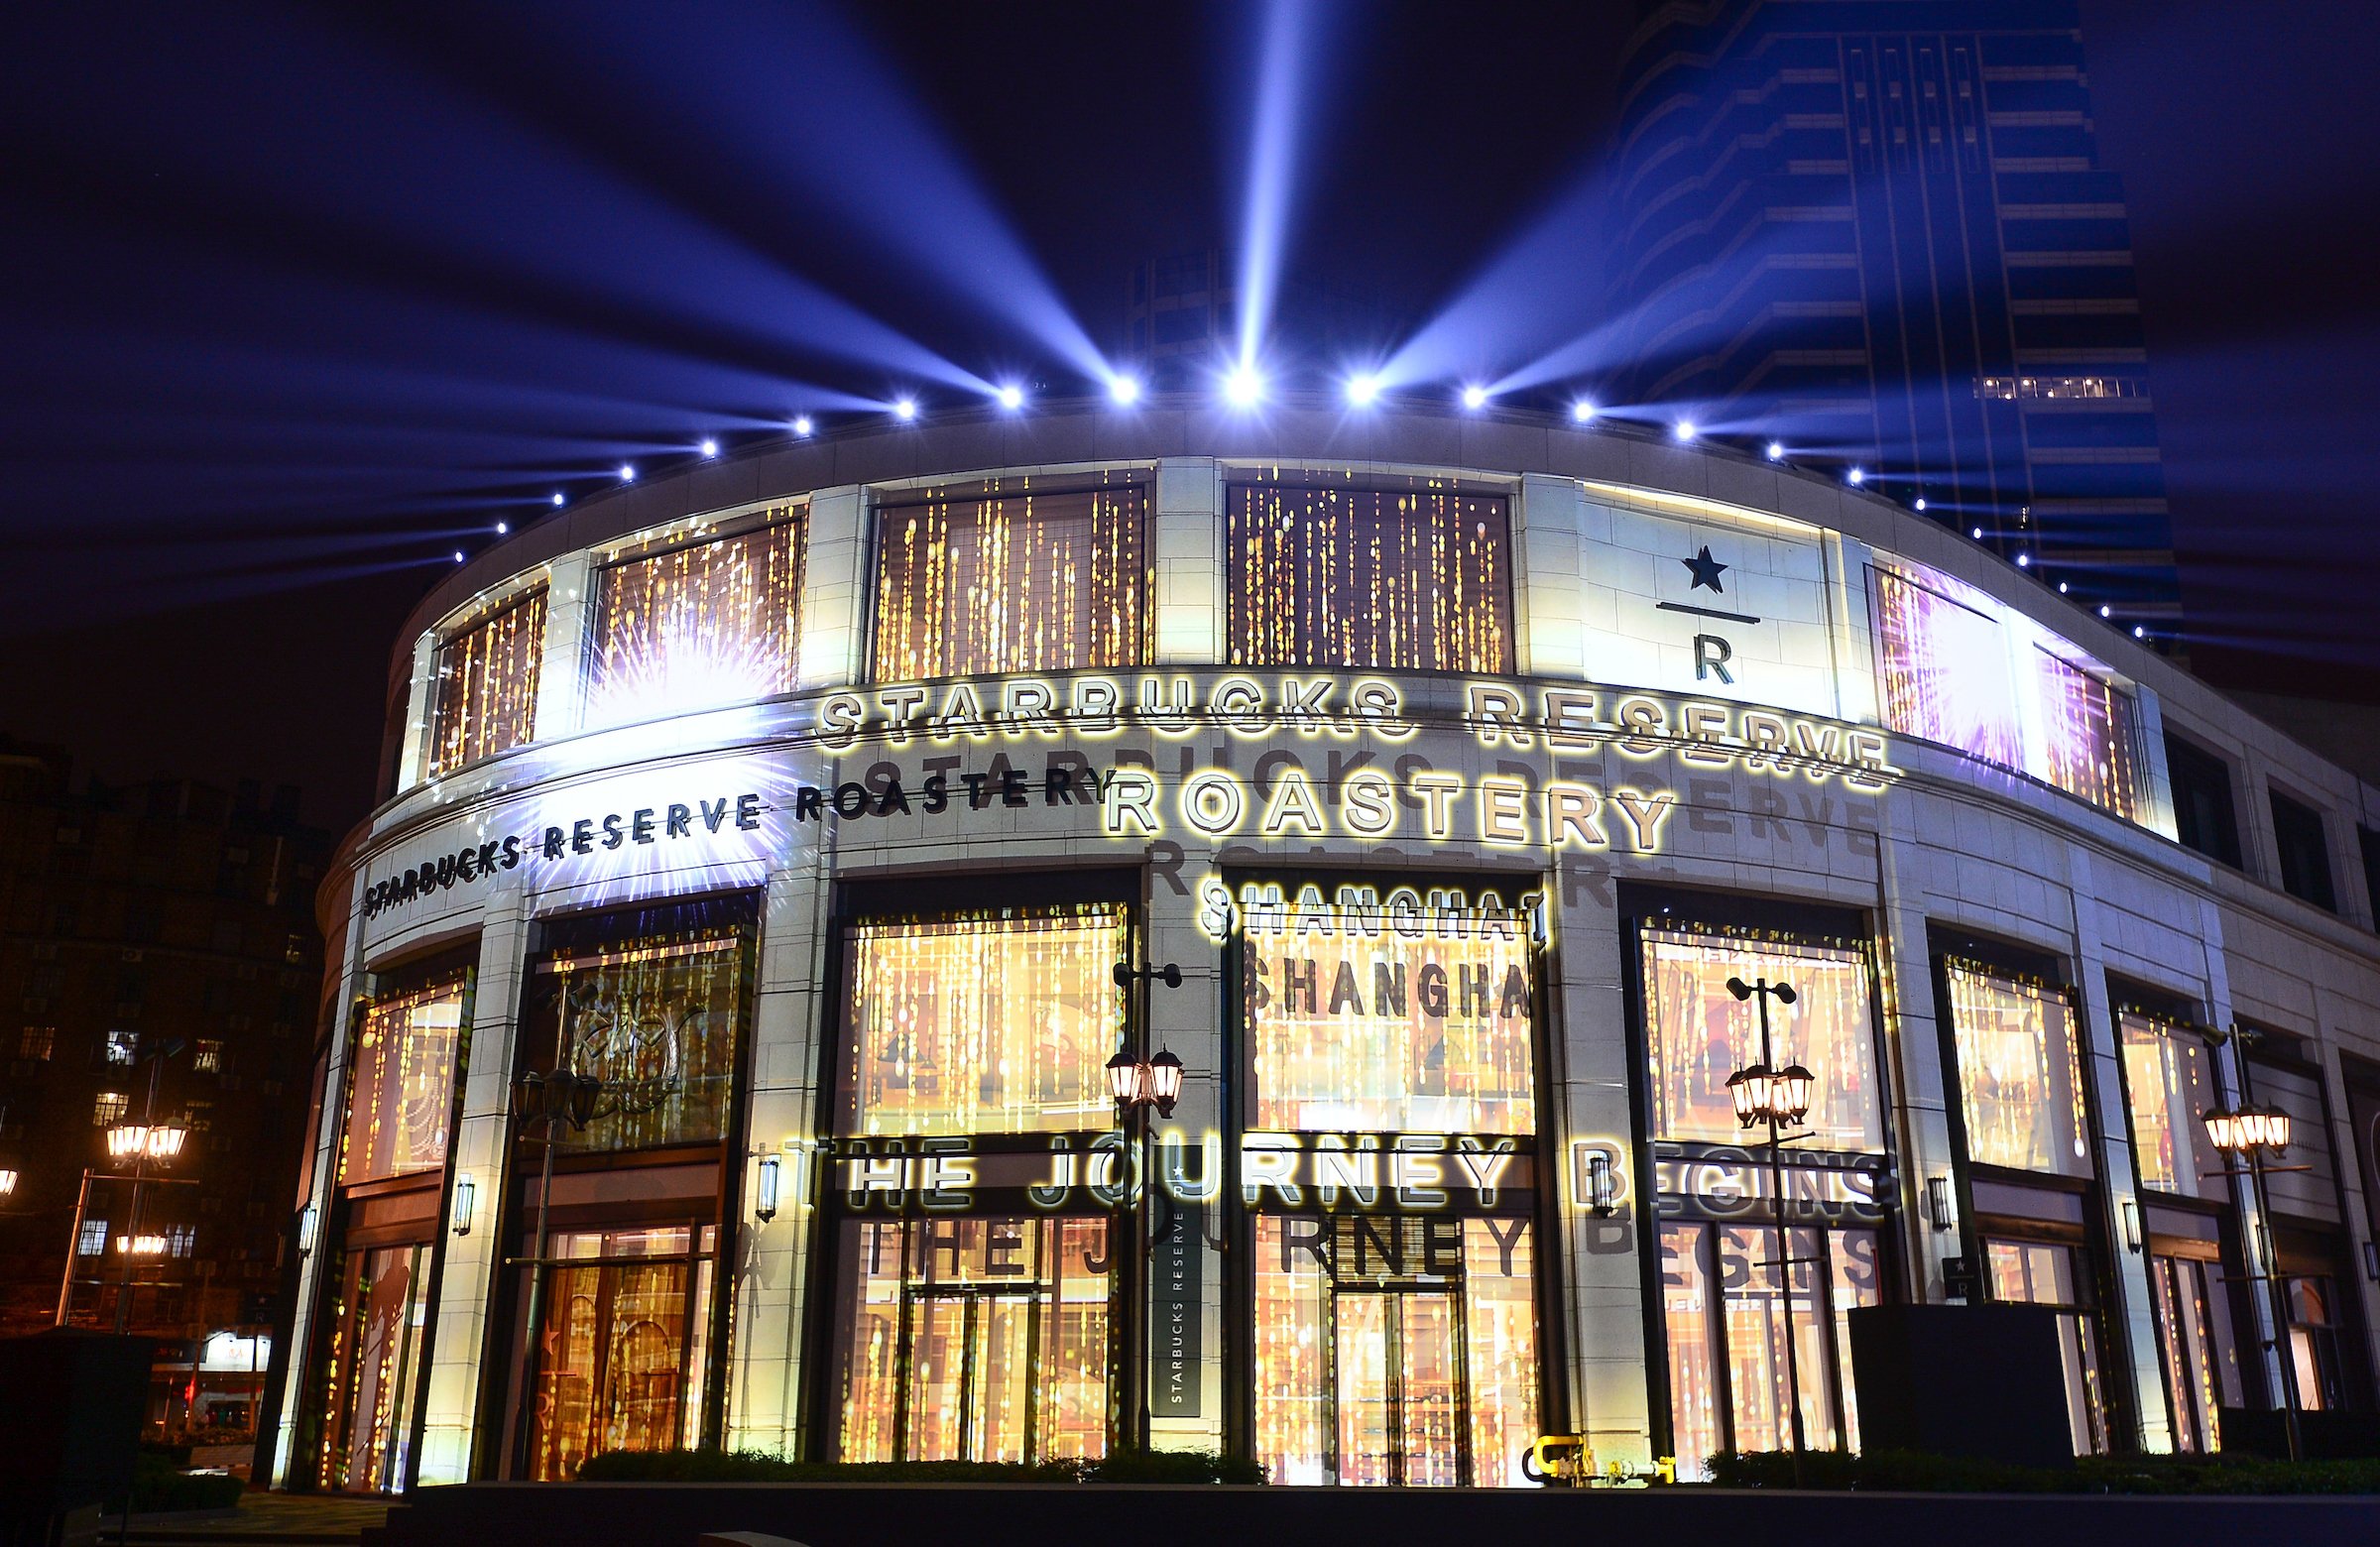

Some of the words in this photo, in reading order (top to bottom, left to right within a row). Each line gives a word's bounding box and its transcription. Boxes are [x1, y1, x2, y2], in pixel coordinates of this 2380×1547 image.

[1694, 634, 1734, 684] R
[813, 680, 1414, 749] STARBUCKS
[1469, 686, 1887, 787] RESERVE
[364, 835, 521, 920] STARBUCKS
[543, 793, 760, 861] RESERVE
[795, 767, 1116, 822] ROASTERY
[1108, 773, 1673, 850] ROASTERY
[1173, 1212, 1185, 1292] RESERVE
[1171, 1302, 1184, 1404] STARBUCKS
